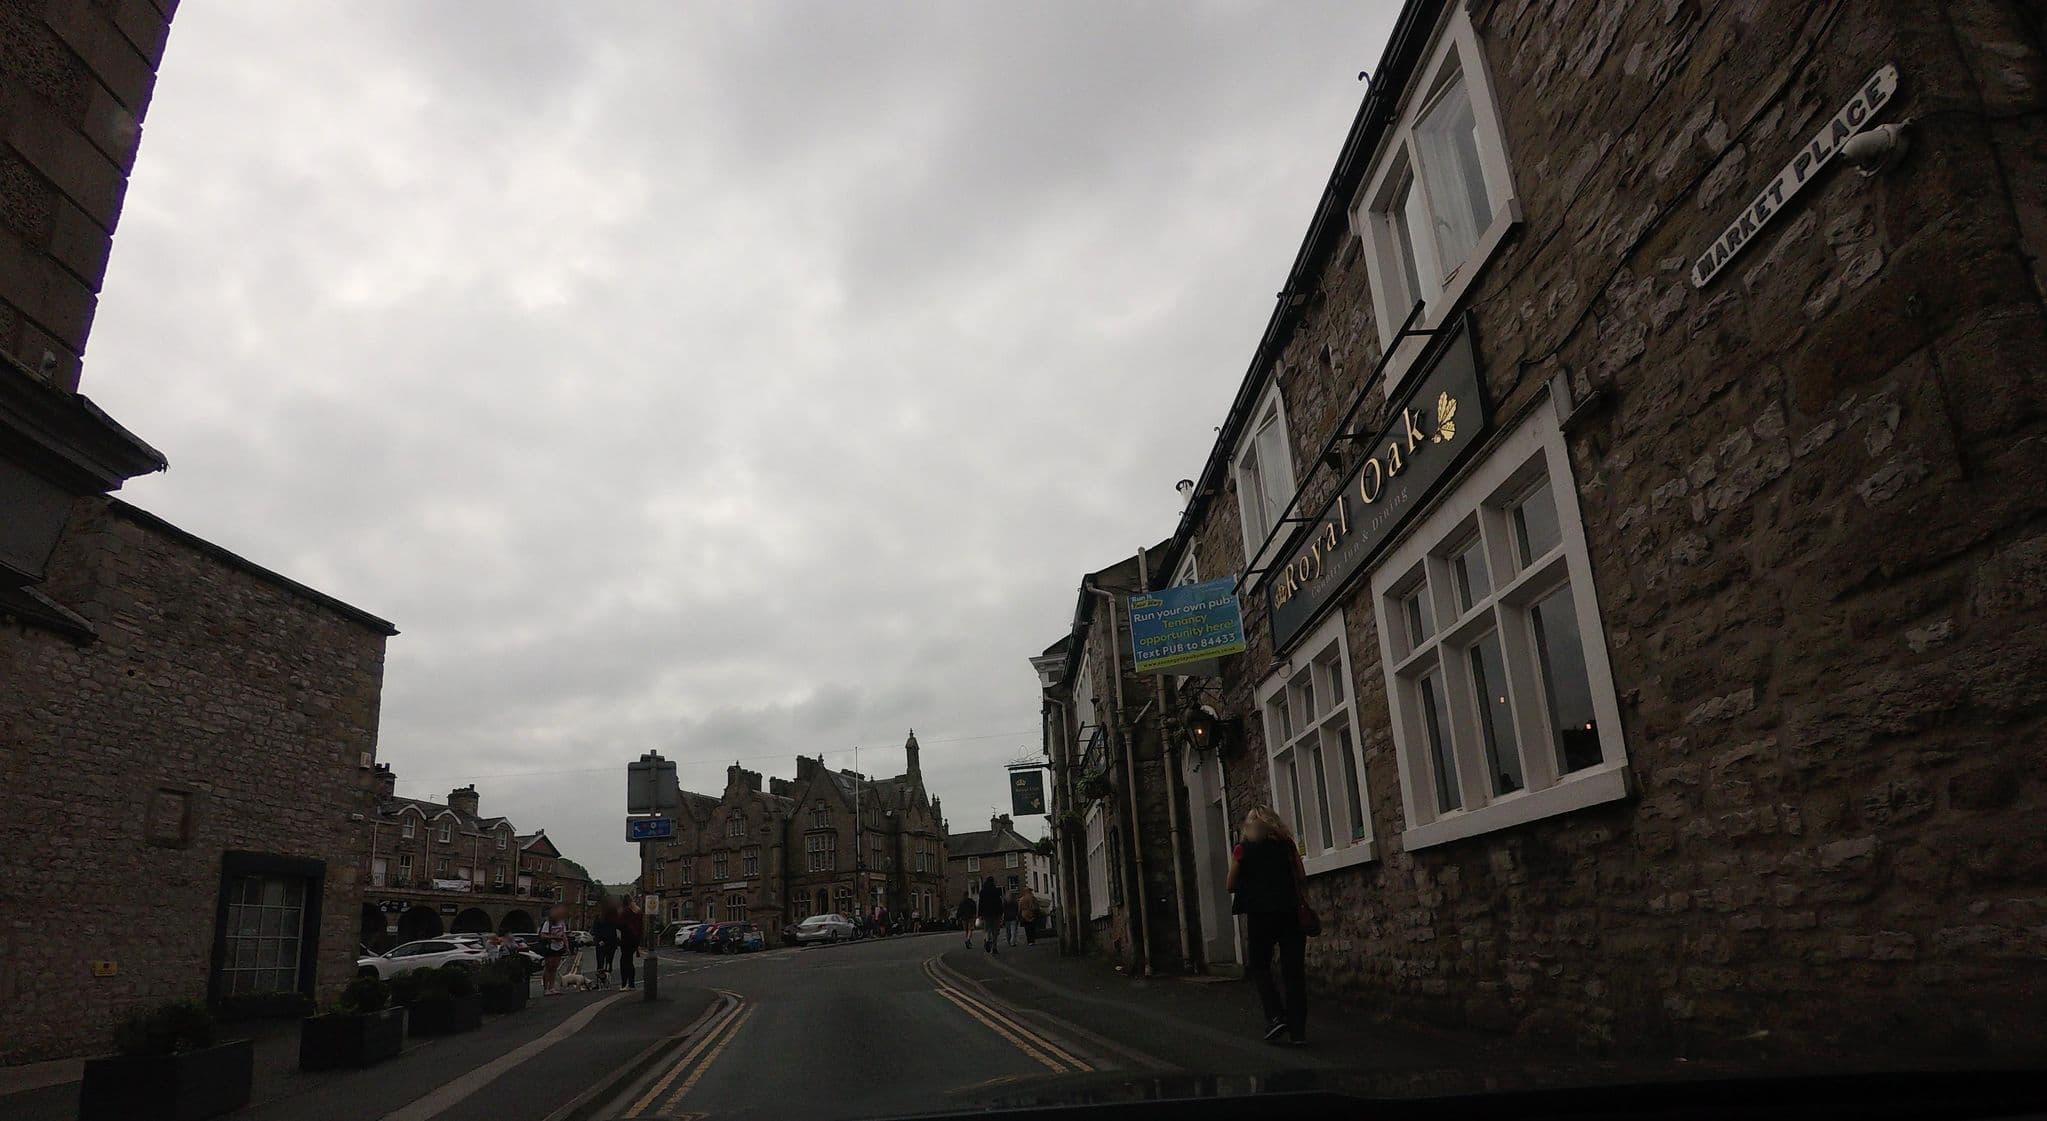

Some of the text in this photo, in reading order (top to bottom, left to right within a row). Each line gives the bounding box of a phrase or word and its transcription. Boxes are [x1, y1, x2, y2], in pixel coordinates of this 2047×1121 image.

[1697, 76, 1887, 281] MARKET PLACE
[1284, 406, 1425, 598] Royal Oak
[1343, 541, 1361, 563] Inn
[1361, 528, 1371, 545] &
[1371, 486, 1409, 532] Dining
[1134, 613, 1155, 622] Run
[1156, 607, 1181, 620] your
[1183, 601, 1206, 613] own
[1162, 614, 1208, 628] Tenancy
[1137, 648, 1161, 660] Text
[1163, 643, 1184, 655] PUB
[1186, 641, 1198, 651] to
[1201, 633, 1236, 648] 84433
[1139, 628, 1204, 646] opportunity
